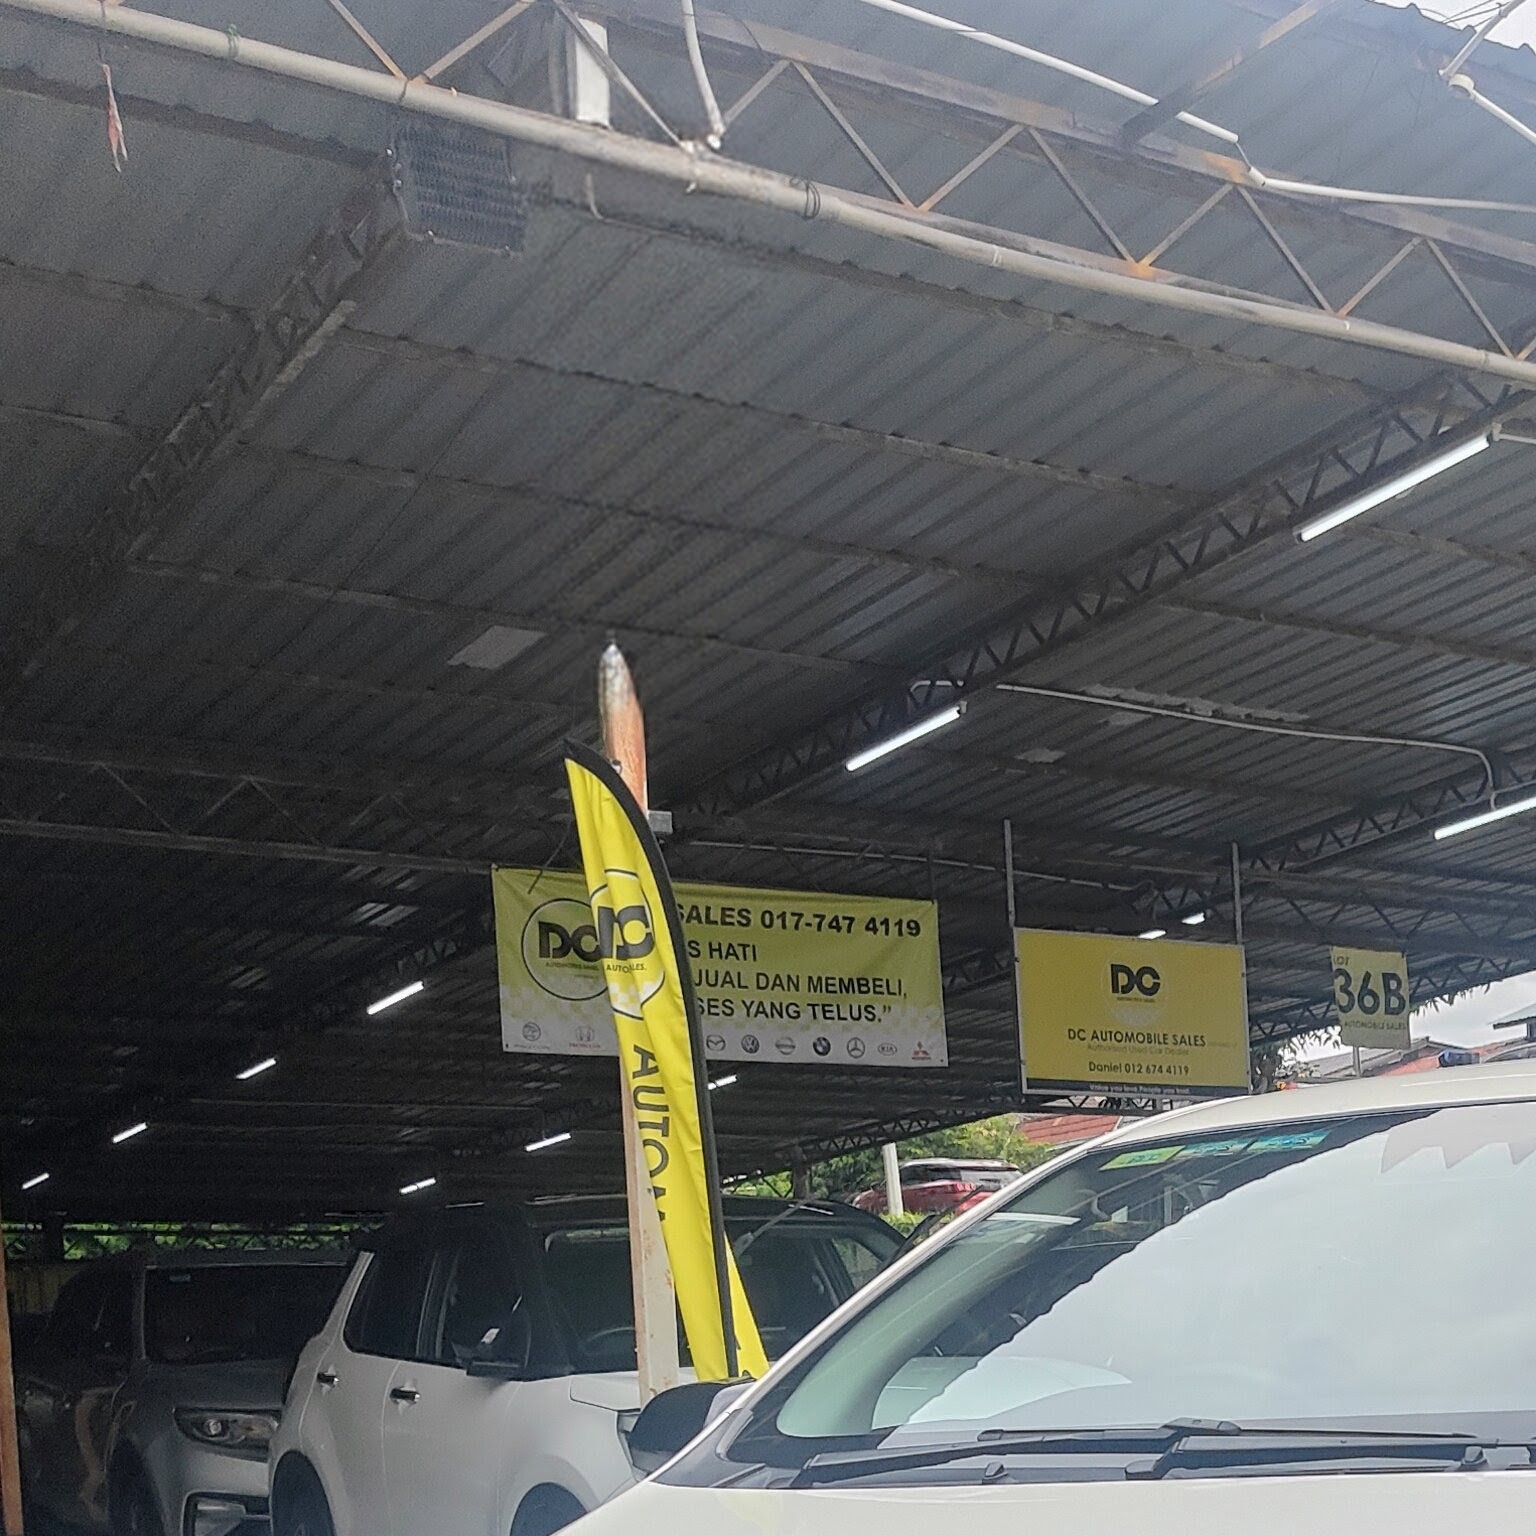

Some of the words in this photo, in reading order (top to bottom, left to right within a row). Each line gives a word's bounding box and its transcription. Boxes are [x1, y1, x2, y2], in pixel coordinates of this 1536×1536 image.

[761, 909, 855, 934] 017-747
[865, 917, 921, 938] 4119
[708, 942, 757, 962] HATI
[756, 972, 800, 992] DAN
[807, 975, 907, 999] MEMBELI,
[1110, 964, 1161, 996] DC
[1334, 968, 1406, 1015] 36B
[742, 1000, 801, 1020] YANG
[1067, 1028, 1086, 1040] DC
[1090, 1030, 1169, 1045] AUTOMOBILE
[1172, 1034, 1206, 1047] SALES
[1088, 1061, 1122, 1073] Daniel
[1124, 1062, 1142, 1074] 012
[1145, 1063, 1163, 1074] 674
[1166, 1064, 1189, 1075] 4119
